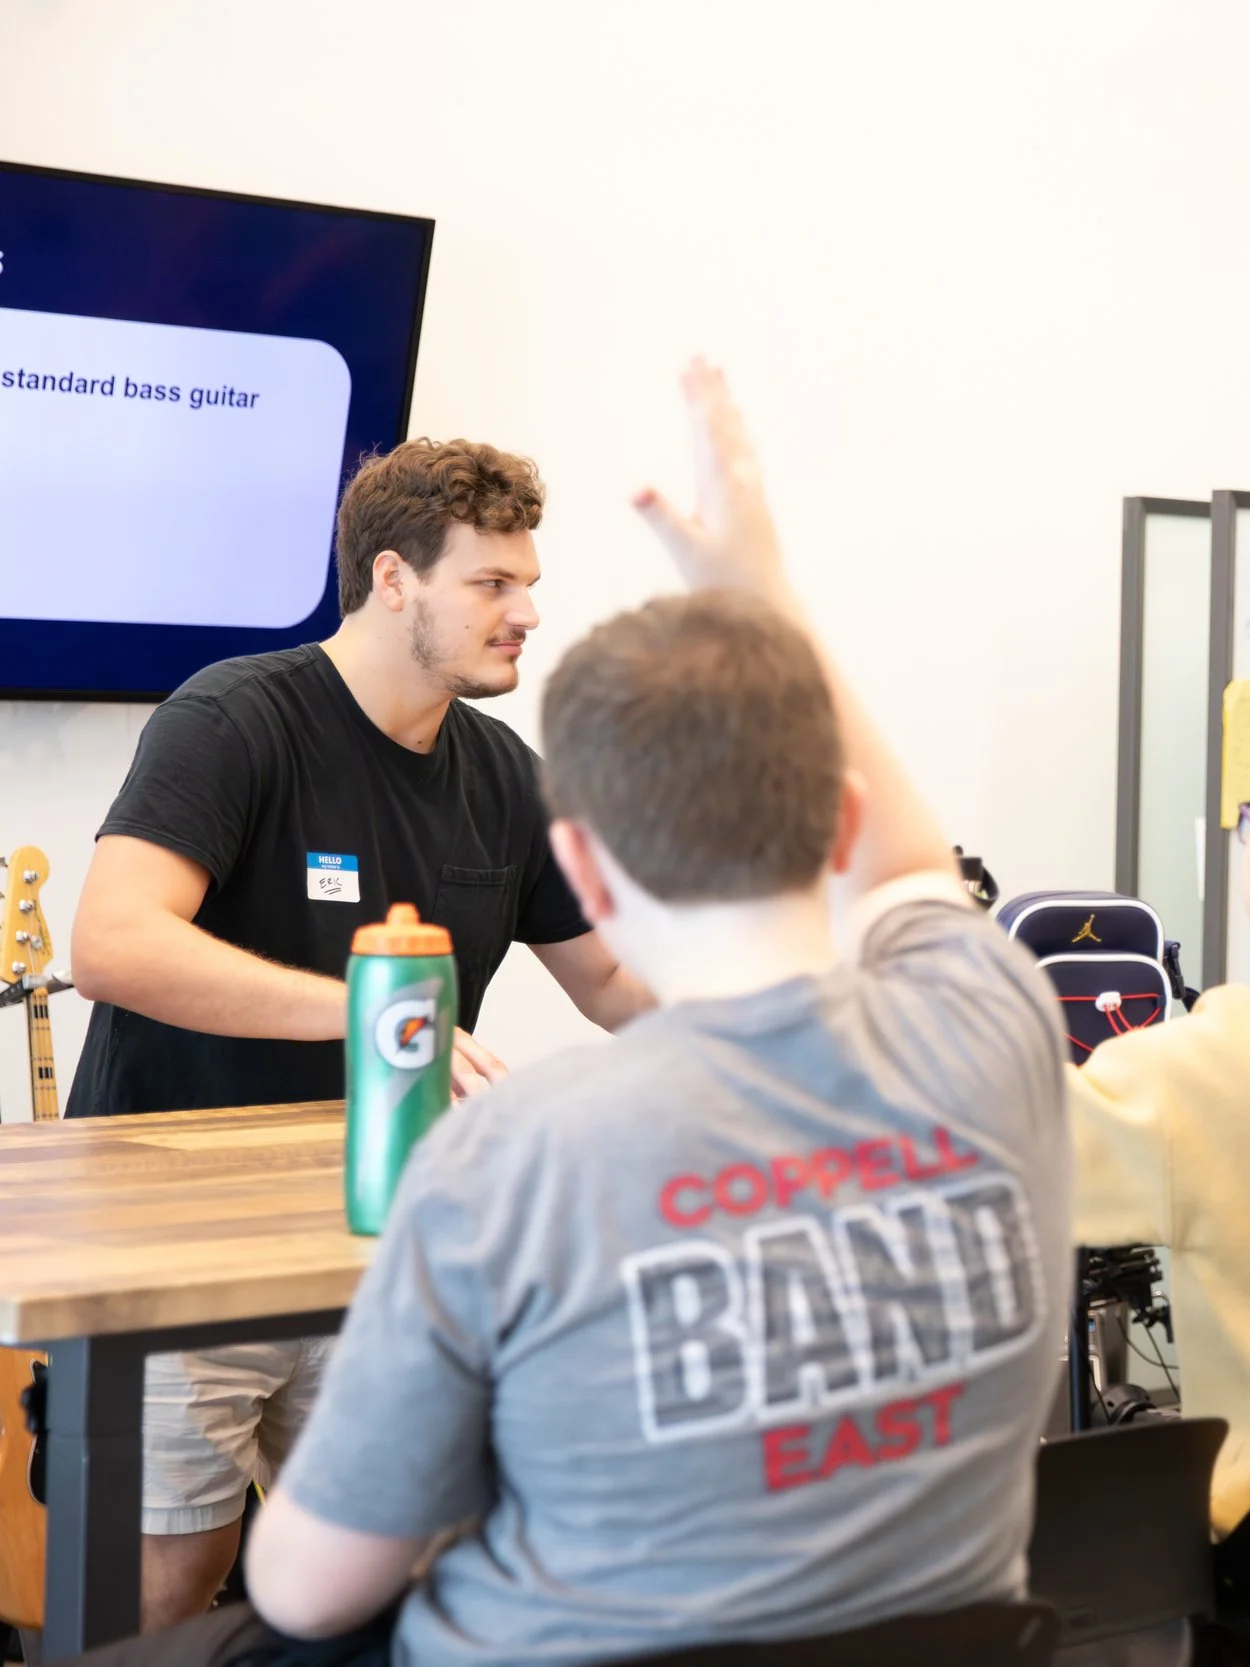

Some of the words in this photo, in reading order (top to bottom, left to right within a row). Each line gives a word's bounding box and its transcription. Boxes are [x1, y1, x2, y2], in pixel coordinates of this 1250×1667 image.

[1, 367, 116, 397] standard
[123, 376, 182, 402] bass
[188, 385, 260, 410] guitar
[318, 855, 342, 865] HELLO
[375, 998, 437, 1070] G
[658, 1125, 978, 1229] COPPELL
[621, 1172, 1047, 1445] BAND
[761, 1381, 968, 1493] EAST
